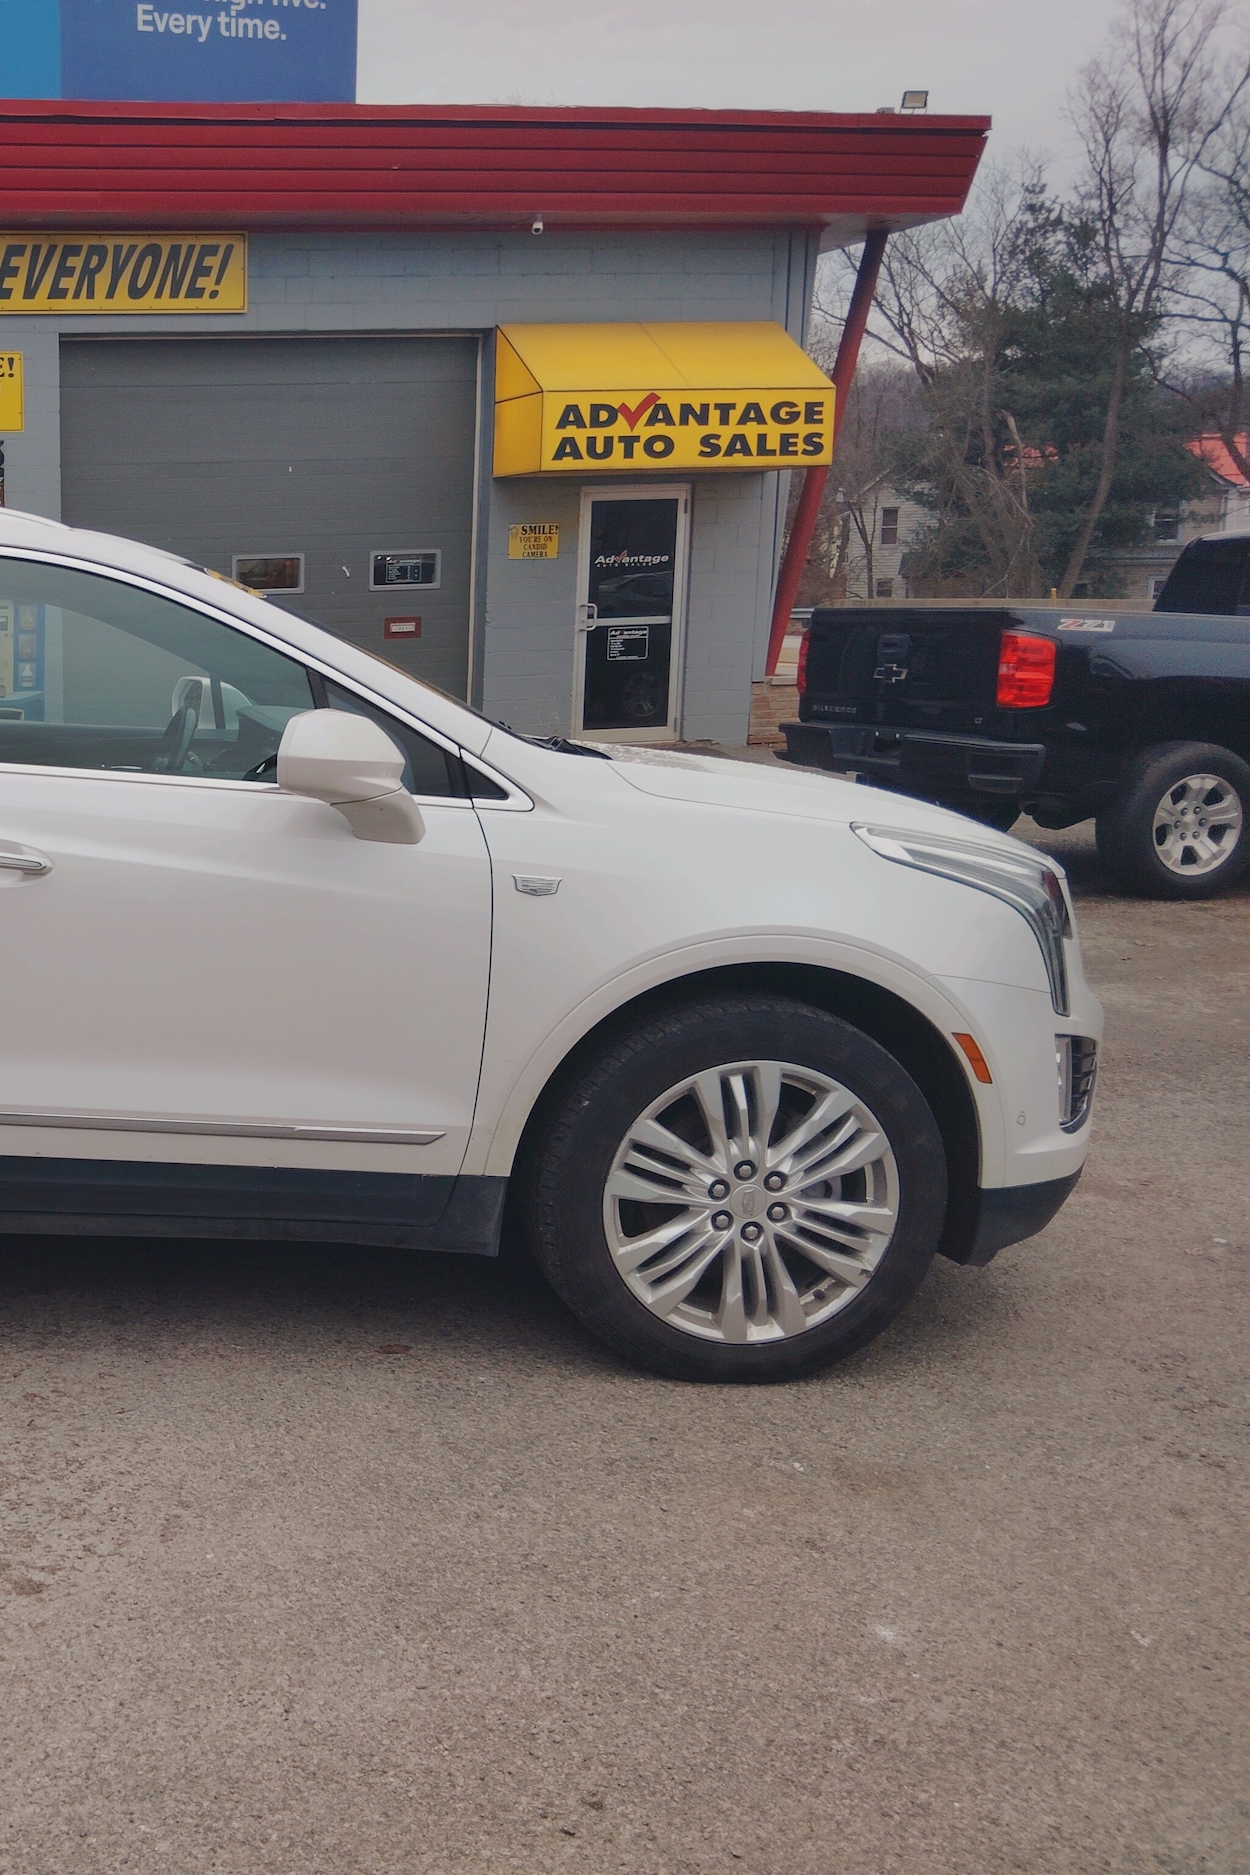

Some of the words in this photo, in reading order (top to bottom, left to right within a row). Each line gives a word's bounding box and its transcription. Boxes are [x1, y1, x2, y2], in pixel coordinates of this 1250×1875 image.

[136, 4, 213, 42] Every
[217, 10, 287, 41] time.
[551, 434, 675, 461] AUTO
[698, 432, 825, 458] SALES
[521, 525, 558, 535] SMILE!
[1057, 618, 1116, 633] Z71
